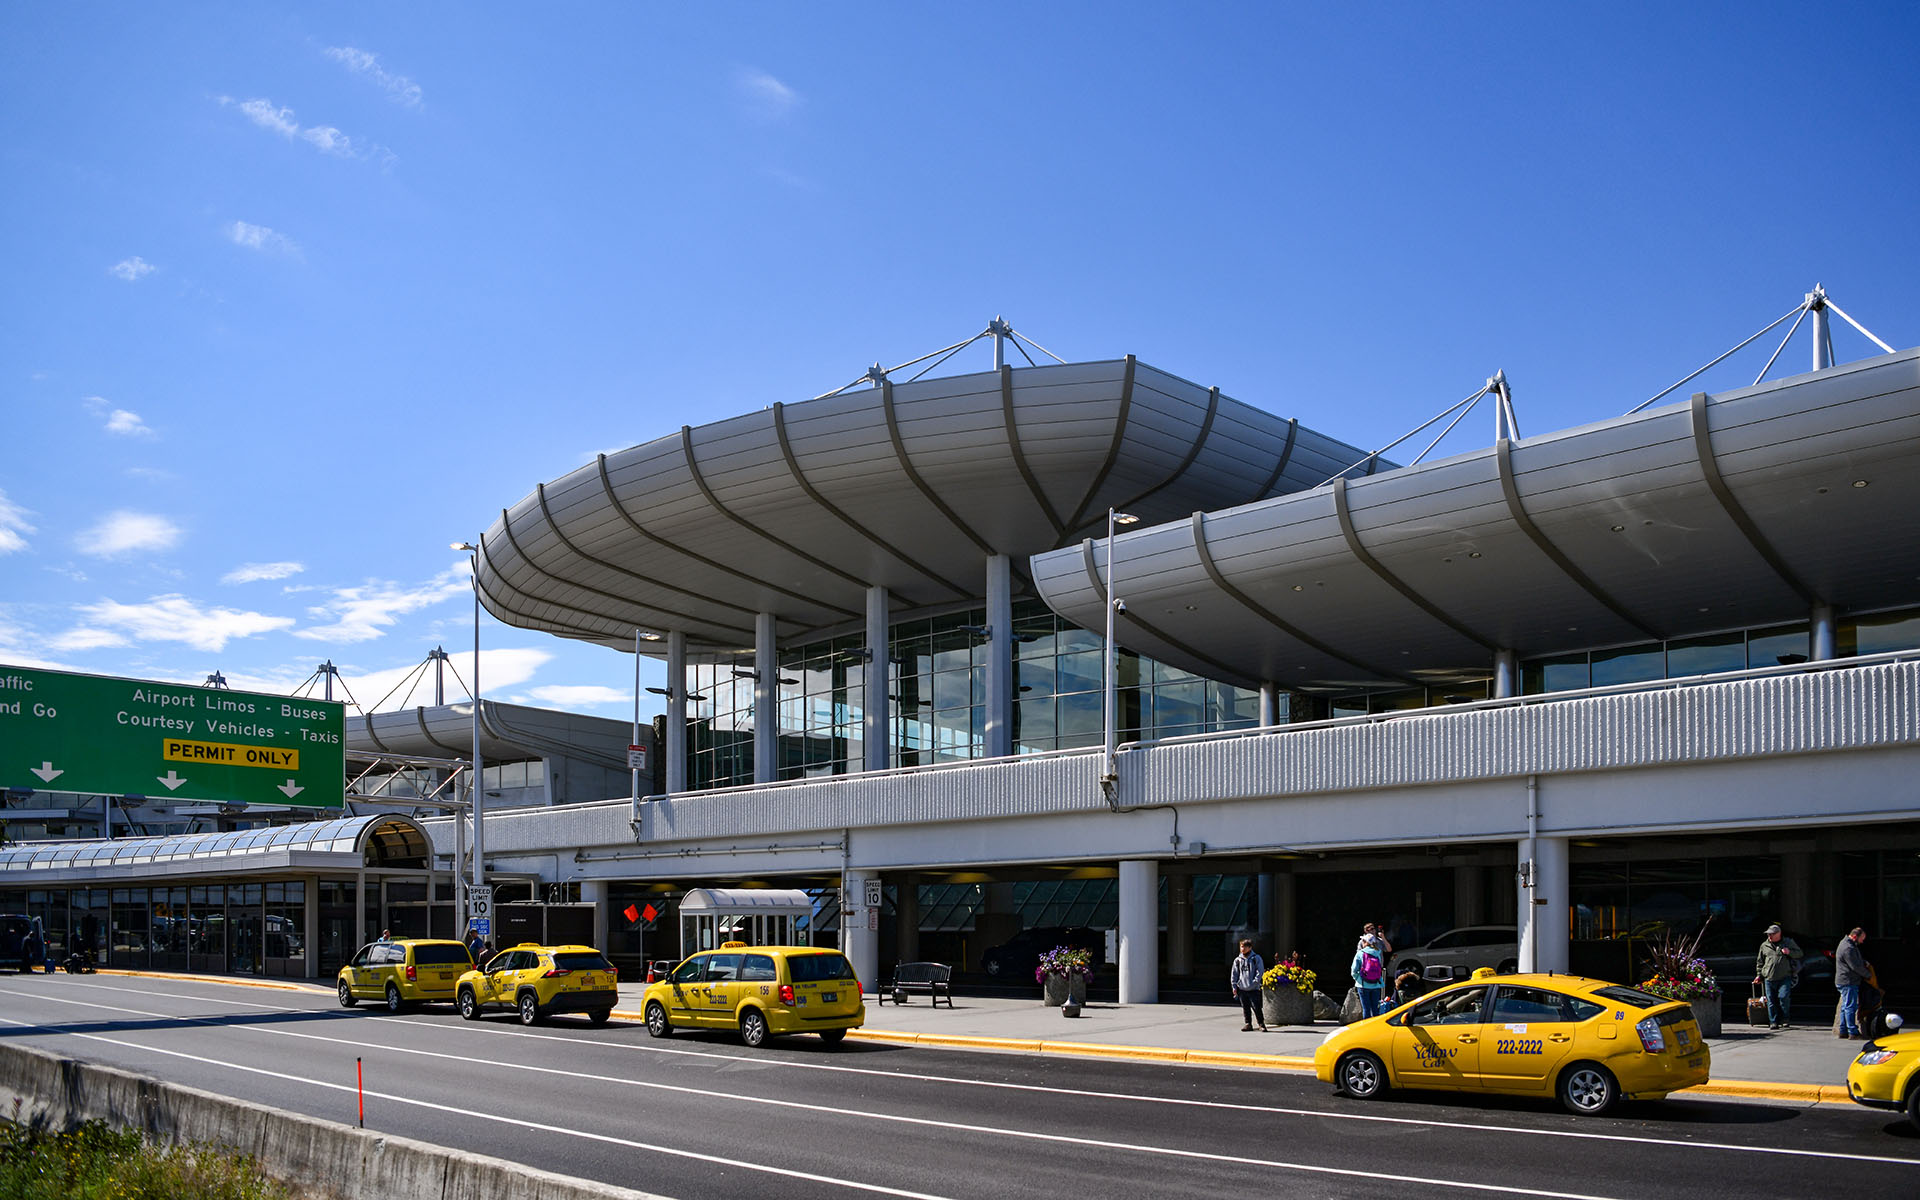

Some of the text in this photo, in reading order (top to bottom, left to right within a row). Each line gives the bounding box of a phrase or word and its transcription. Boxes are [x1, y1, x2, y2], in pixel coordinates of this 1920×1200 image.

[33, 703, 57, 718] Go
[132, 688, 195, 707] Airport
[206, 696, 256, 713] Limos
[281, 704, 327, 720] Buses
[117, 711, 195, 734] Courtesy
[206, 719, 275, 738] Vehicles
[300, 728, 339, 744] Taxis
[170, 743, 293, 765] PERMIT ONLY
[868, 893, 879, 904] 10
[473, 901, 487, 914] 10
[760, 986, 769, 995] 156
[1615, 1011, 1625, 1020] 89
[1413, 1042, 1458, 1059] Yellow
[1497, 1039, 1543, 1055] 222-2222
[1422, 1058, 1446, 1068] Cab
